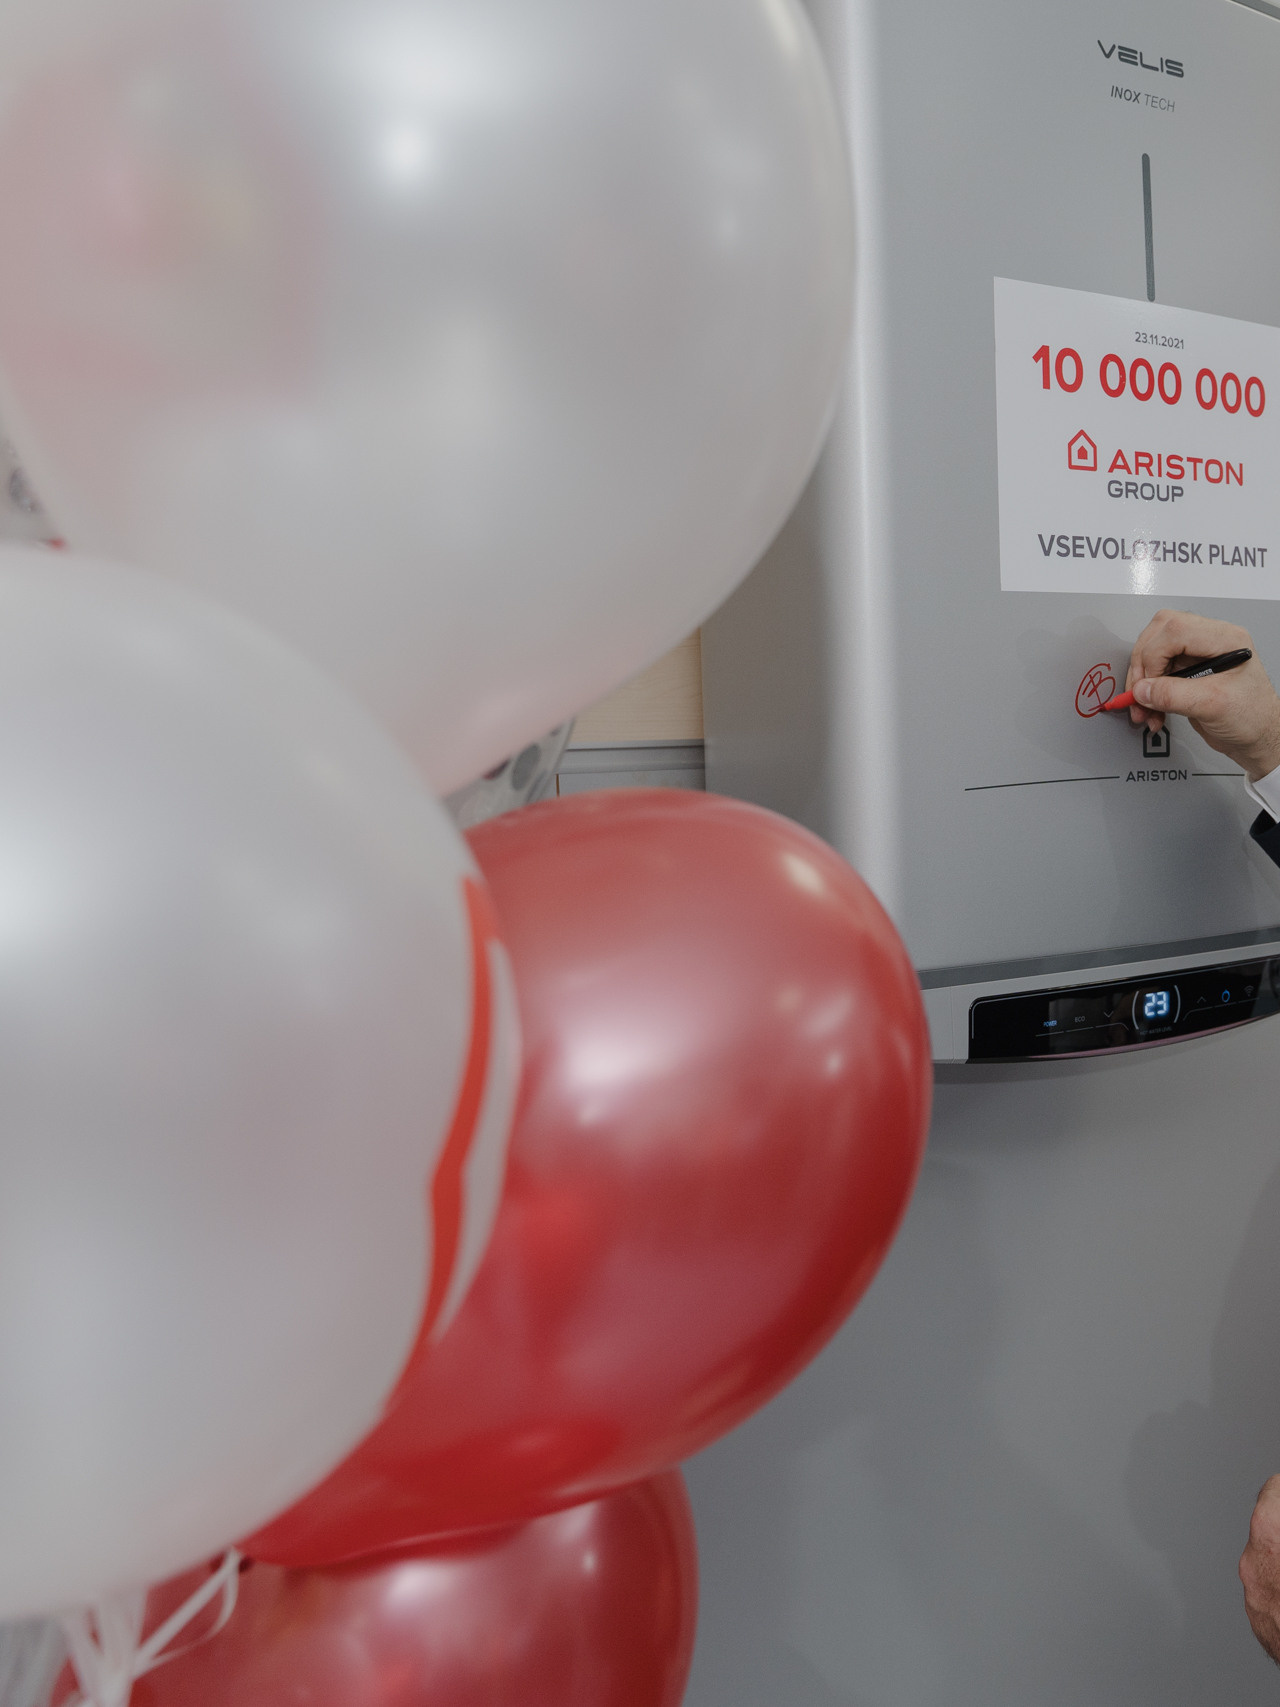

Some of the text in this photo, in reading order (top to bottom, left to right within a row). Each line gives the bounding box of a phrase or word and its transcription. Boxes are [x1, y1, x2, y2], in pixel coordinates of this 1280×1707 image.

[1097, 39, 1184, 78] VELIS
[1110, 85, 1176, 113] INOX TECH
[1134, 331, 1185, 350] 23.11.2021
[1032, 344, 1266, 418] 10 000 000
[1107, 448, 1244, 487] ARISTON
[1107, 479, 1185, 503] GROUP
[1037, 533, 1268, 568] VSEVOLOZHSK PLANT
[1125, 769, 1188, 782] ARISTON
[1144, 991, 1168, 1017] 23
[1043, 1019, 1058, 1027] POWER
[1074, 1015, 1086, 1023] ECO
